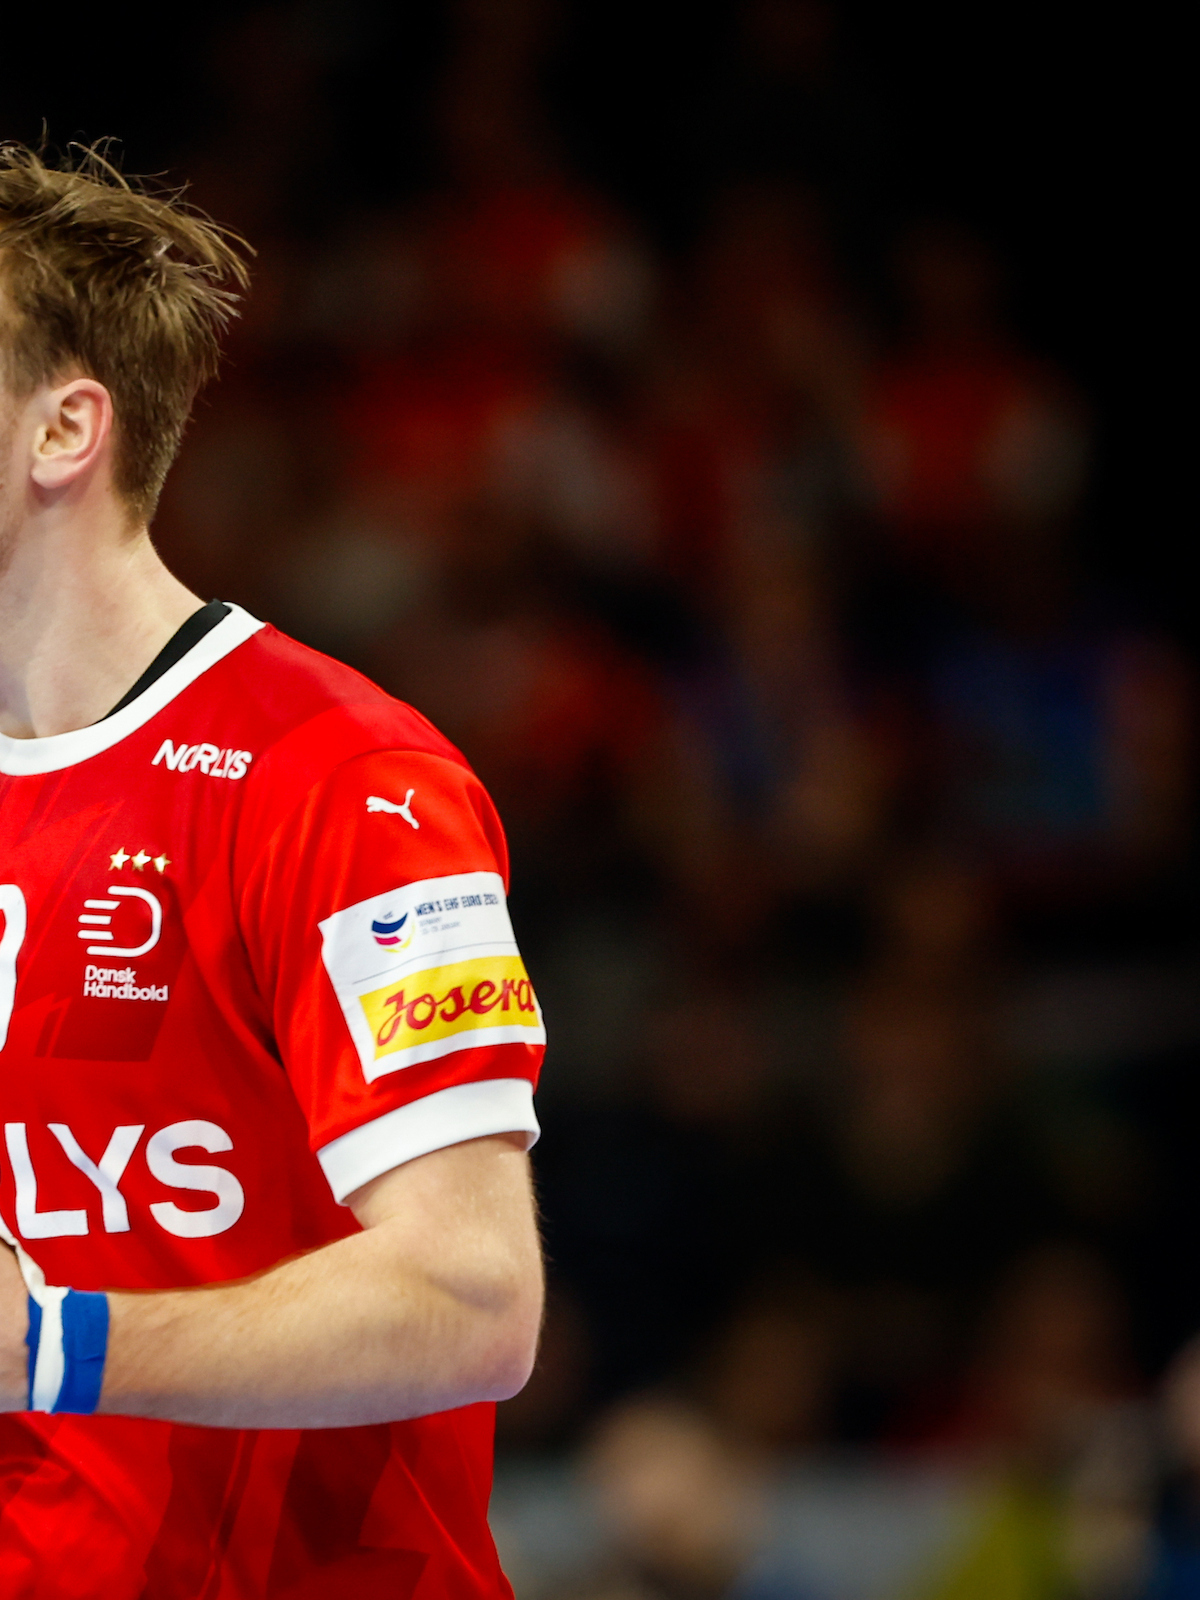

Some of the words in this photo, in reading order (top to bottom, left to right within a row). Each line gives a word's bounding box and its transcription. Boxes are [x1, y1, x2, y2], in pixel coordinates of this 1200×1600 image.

[152, 739, 253, 780] NORLYS
[443, 896, 460, 911] EHF
[85, 964, 137, 984] Dansk
[83, 980, 169, 1002] Håndbold
[377, 979, 535, 1047] Josera
